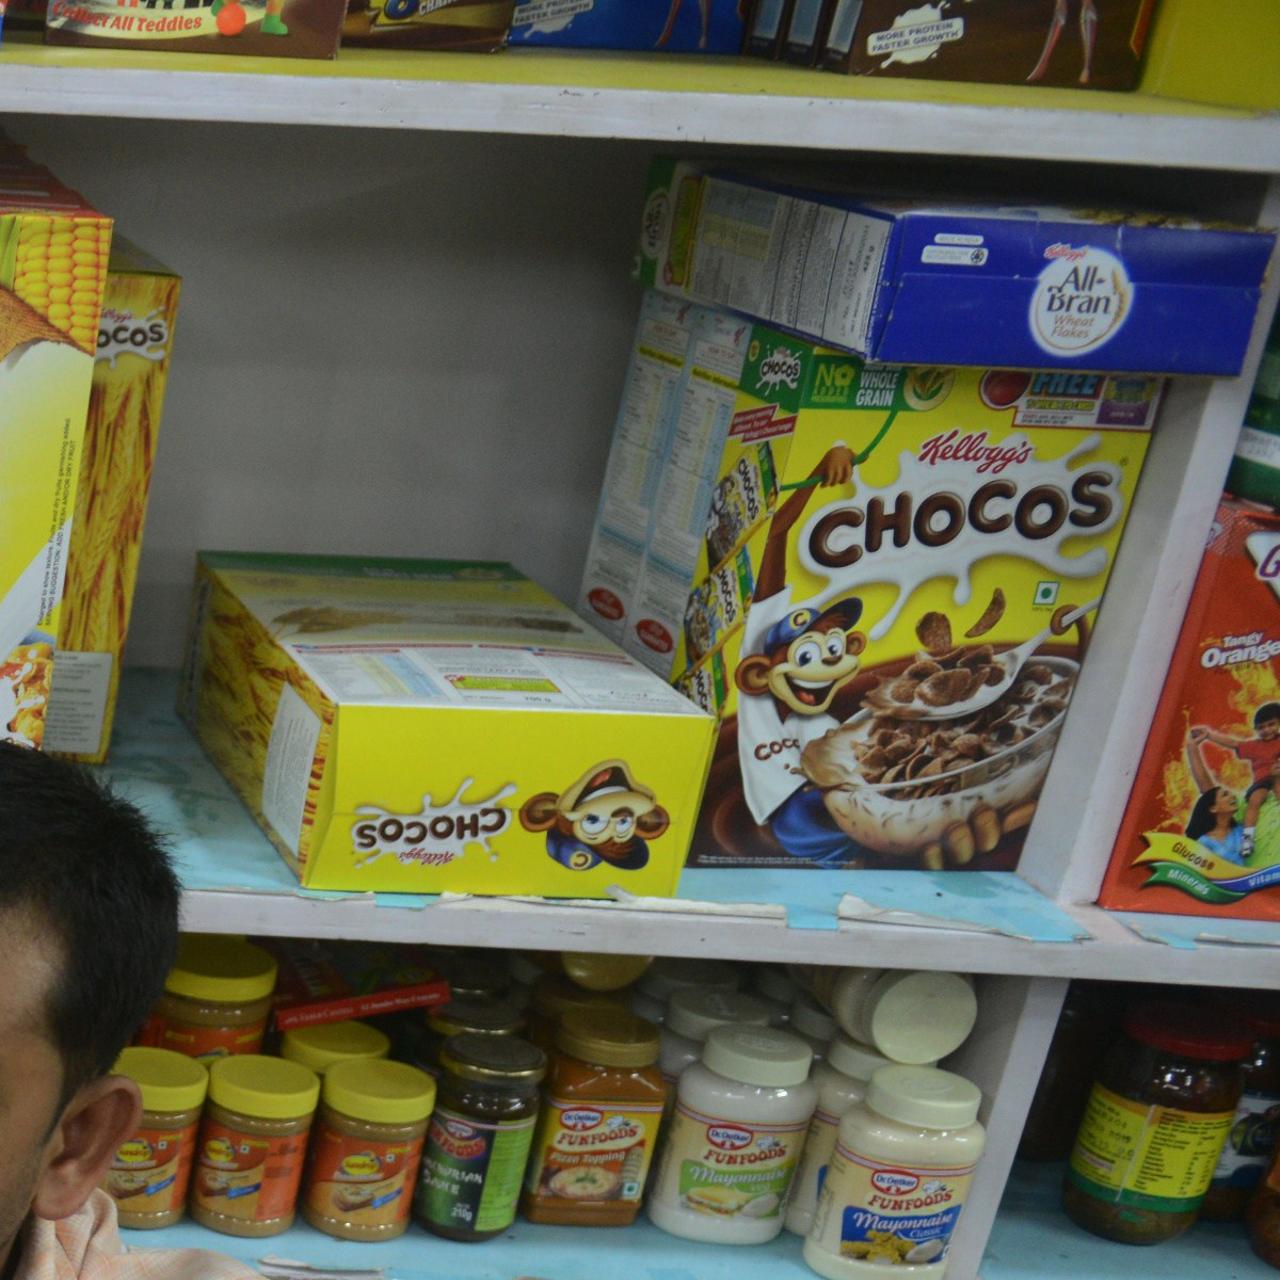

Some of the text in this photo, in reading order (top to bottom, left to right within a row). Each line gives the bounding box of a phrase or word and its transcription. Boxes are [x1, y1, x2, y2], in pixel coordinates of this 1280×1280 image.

[111, 17, 133, 31] All
[877, 22, 954, 41] MORE PROTEIN
[873, 30, 959, 51] FASTER GROWTH
[1062, 264, 1106, 293] All-
[1046, 286, 1112, 315] Bran
[1051, 324, 1090, 340] Flakes
[1053, 314, 1095, 329] Wheat
[760, 355, 801, 378] CHOCOS
[859, 366, 899, 389] WHOLE
[855, 386, 896, 407] GRAIN
[917, 430, 1033, 473] Kellogg's
[739, 458, 760, 520] CHOCOS
[808, 470, 1115, 570] CHOCOS
[1222, 631, 1263, 648] Tangy
[355, 806, 509, 849] CHOCOS
[400, 846, 456, 867] Kellogg's
[1171, 840, 1216, 873] Glucose
[1167, 868, 1212, 896] Minerals
[557, 1124, 640, 1146] FUNFOODS
[581, 1148, 627, 1166] Topping
[703, 1144, 787, 1166] FUNFOODS
[689, 1165, 789, 1186] Mayonnaise
[867, 1189, 953, 1211] FUNFOODS
[852, 1209, 953, 1233] Mayonnaise
